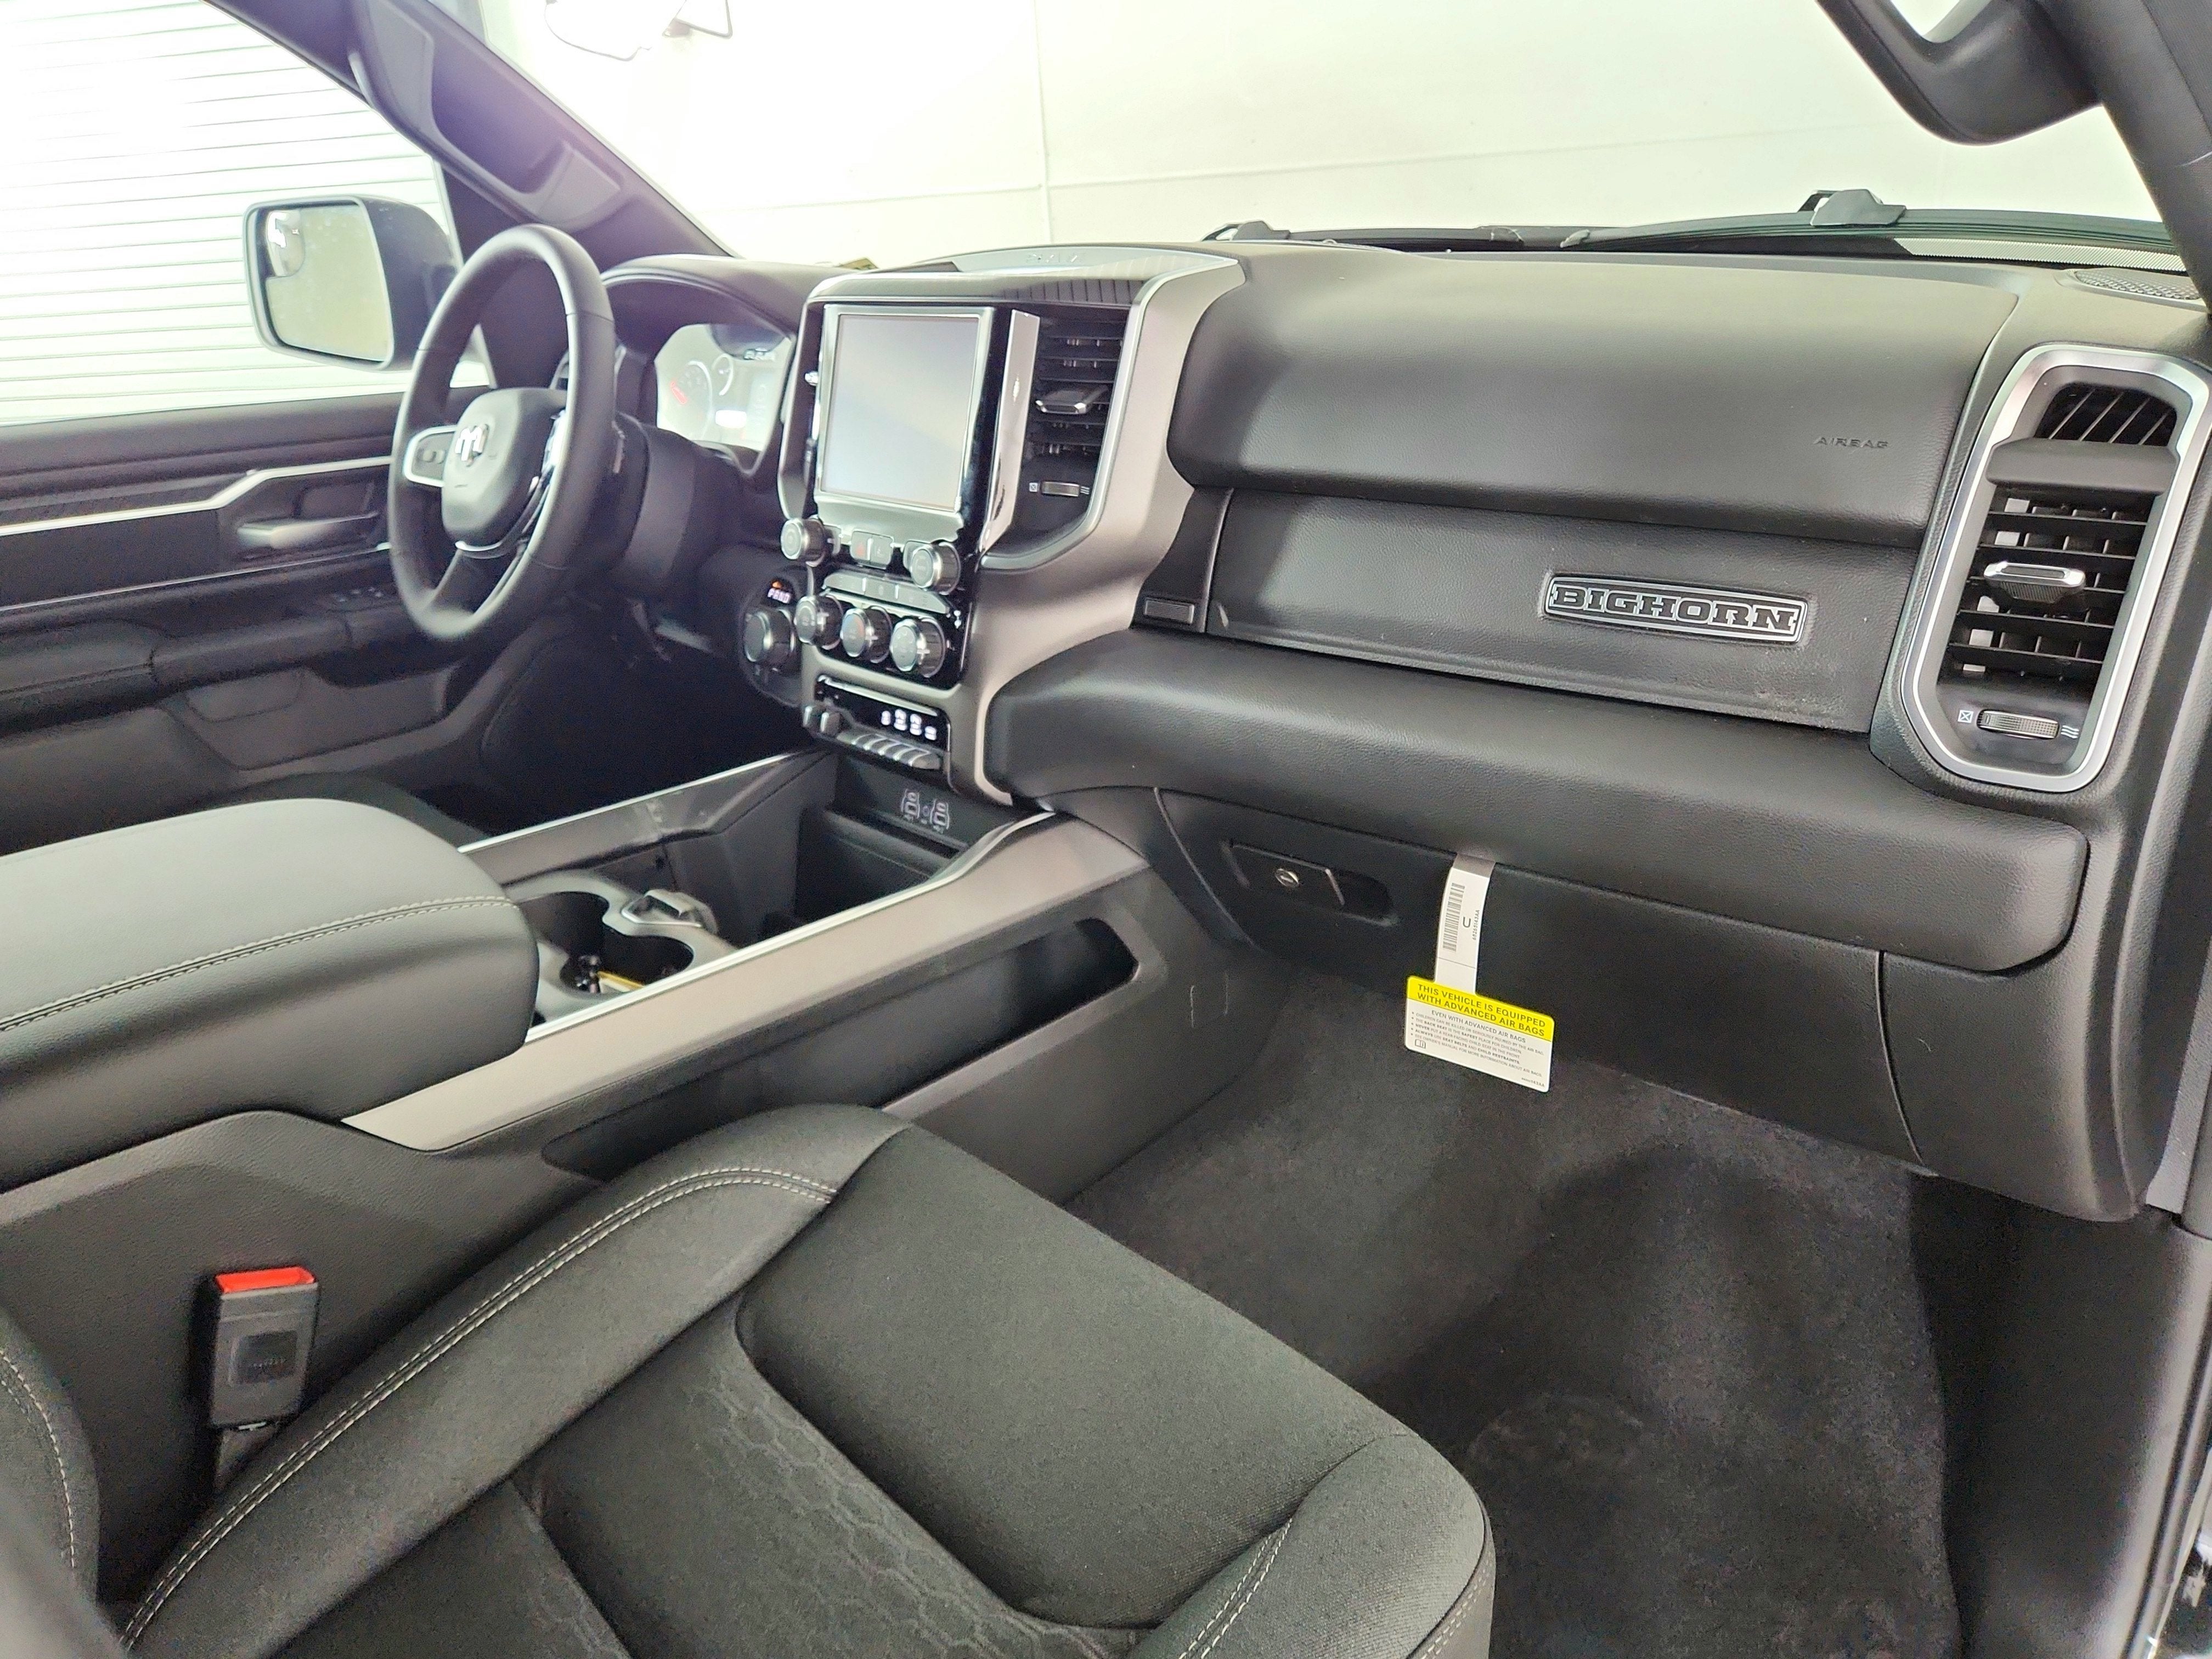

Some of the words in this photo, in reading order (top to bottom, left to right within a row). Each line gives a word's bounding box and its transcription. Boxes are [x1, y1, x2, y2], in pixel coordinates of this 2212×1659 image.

[1813, 437, 1888, 448] AIRBAG
[1549, 583, 1800, 635] BIGHORN
[1463, 917, 1471, 928] U
[1418, 984, 1438, 995] THIS
[1442, 991, 1481, 1008] VEHICLE
[1484, 1003, 1493, 1012] IS
[1496, 1007, 1545, 1028] EQUIPPED
[1418, 992, 1441, 1005] WITH
[1444, 1000, 1496, 1022] ADVANCED
[1499, 1017, 1515, 1028] AIR
[1518, 1023, 1544, 1036] BAGS
[1431, 1010, 1446, 1019] EVEN
[1448, 1015, 1463, 1024] WITH
[1465, 1020, 1497, 1034] ADVANCED
[1510, 1034, 1526, 1043] BAGS
